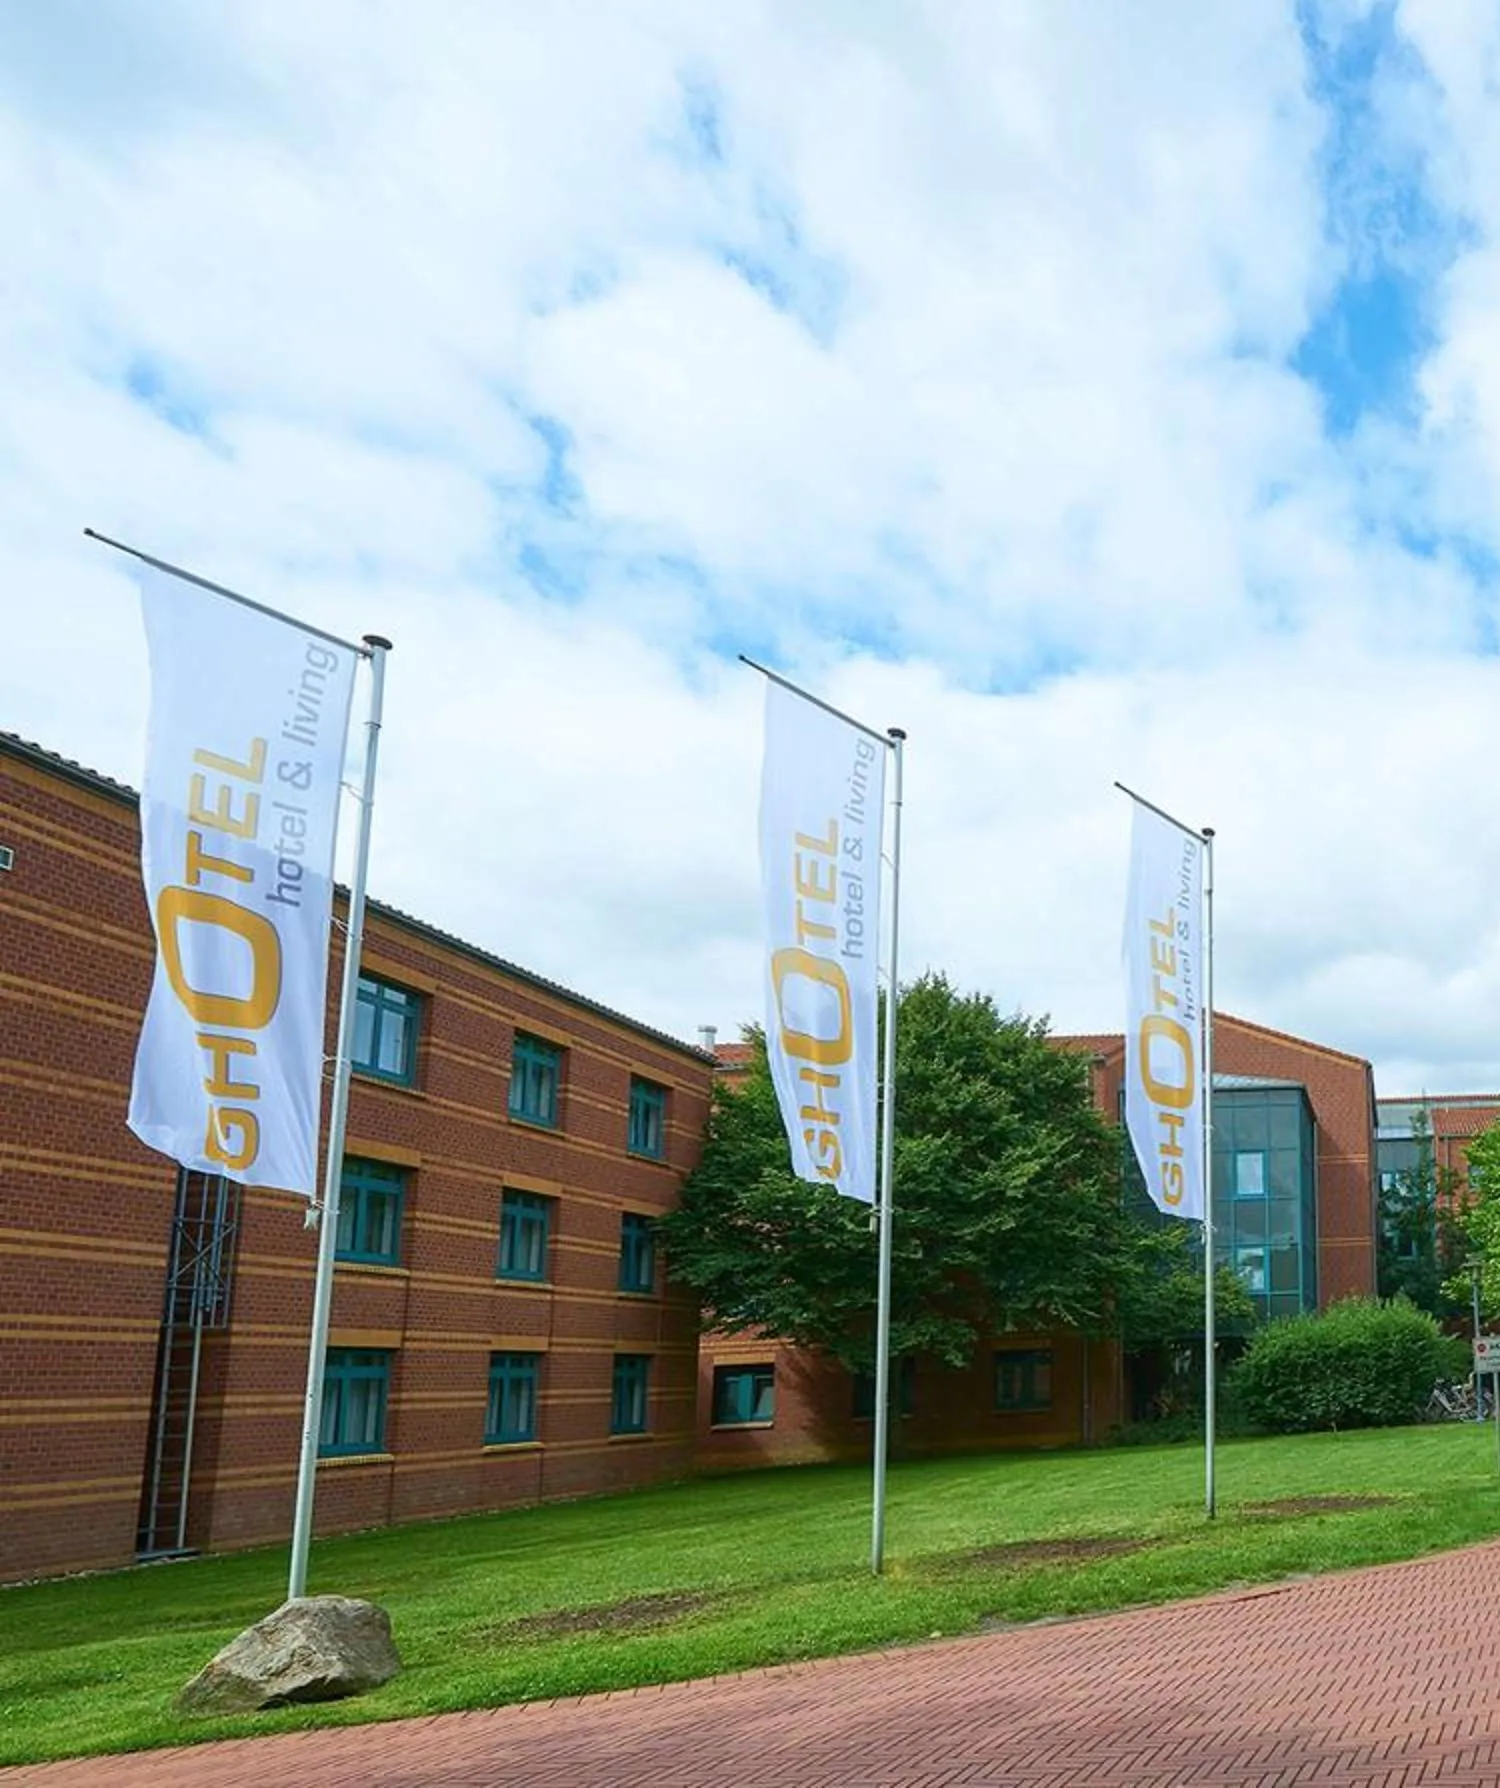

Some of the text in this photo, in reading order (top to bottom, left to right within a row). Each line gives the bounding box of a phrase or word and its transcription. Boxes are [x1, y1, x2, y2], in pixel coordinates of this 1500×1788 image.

[266, 640, 339, 908] hotel & living
[841, 738, 876, 959] hotel & living
[1176, 839, 1197, 911] living
[156, 737, 283, 1171] GHOTEL
[771, 818, 852, 1181] GHOTEL
[1139, 907, 1195, 1207] GHOTEL
[1178, 947, 1196, 1022] hotel
